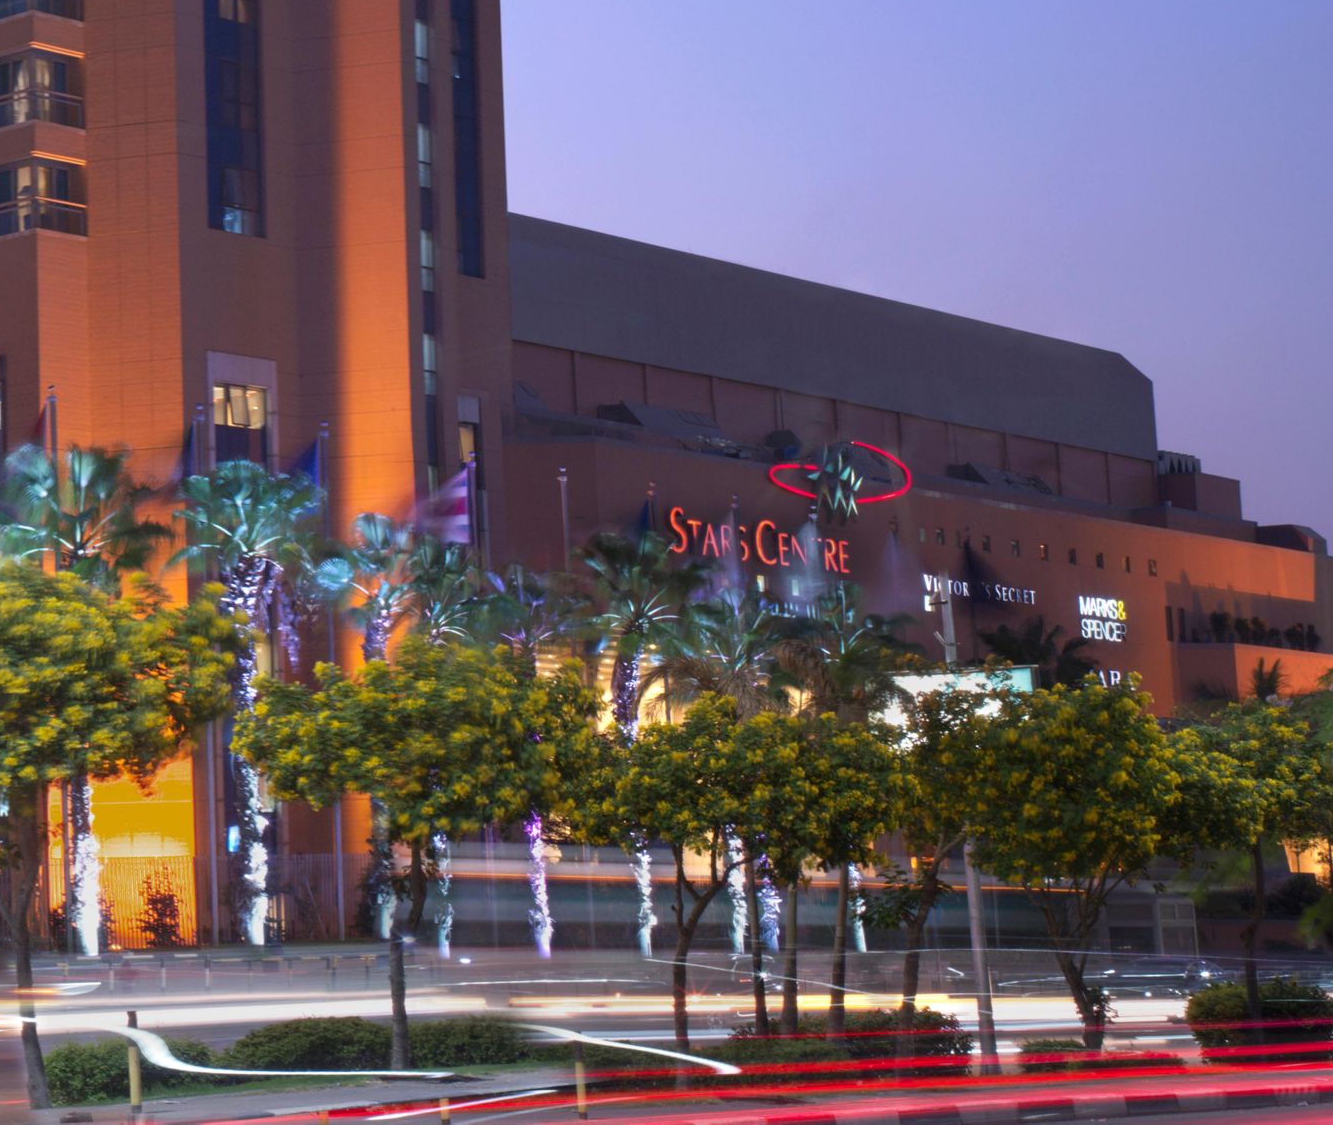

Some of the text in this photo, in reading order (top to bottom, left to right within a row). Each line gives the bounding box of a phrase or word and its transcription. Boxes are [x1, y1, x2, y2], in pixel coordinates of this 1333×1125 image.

[669, 506, 850, 573] STARS CENRE
[995, 584, 1036, 605] SECRET
[1081, 618, 1127, 643] SPENCER
